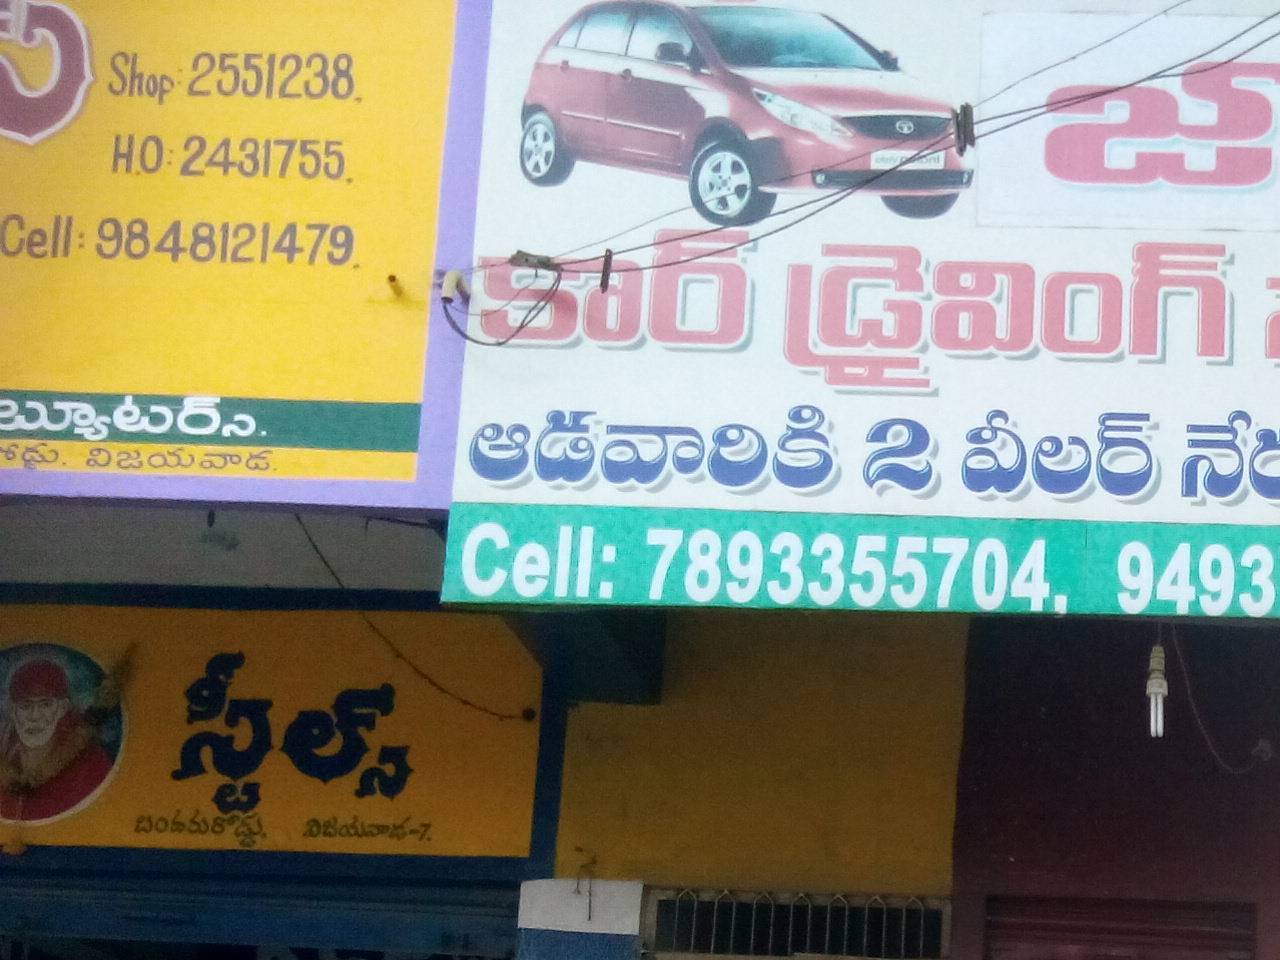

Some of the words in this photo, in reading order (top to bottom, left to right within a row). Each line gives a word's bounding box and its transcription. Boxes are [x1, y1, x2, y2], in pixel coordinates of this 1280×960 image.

[108, 51, 183, 105] Shop:
[1, 214, 86, 259] Cell:
[476, 229, 758, 352] కార్
[782, 240, 1233, 397] డ్రైవింగ్
[468, 404, 841, 495] ఆడవారికి
[862, 417, 940, 493] 2
[960, 410, 1160, 502] వీలర్
[460, 523, 616, 600] Cell:
[647, 528, 1068, 614] 7893355704,
